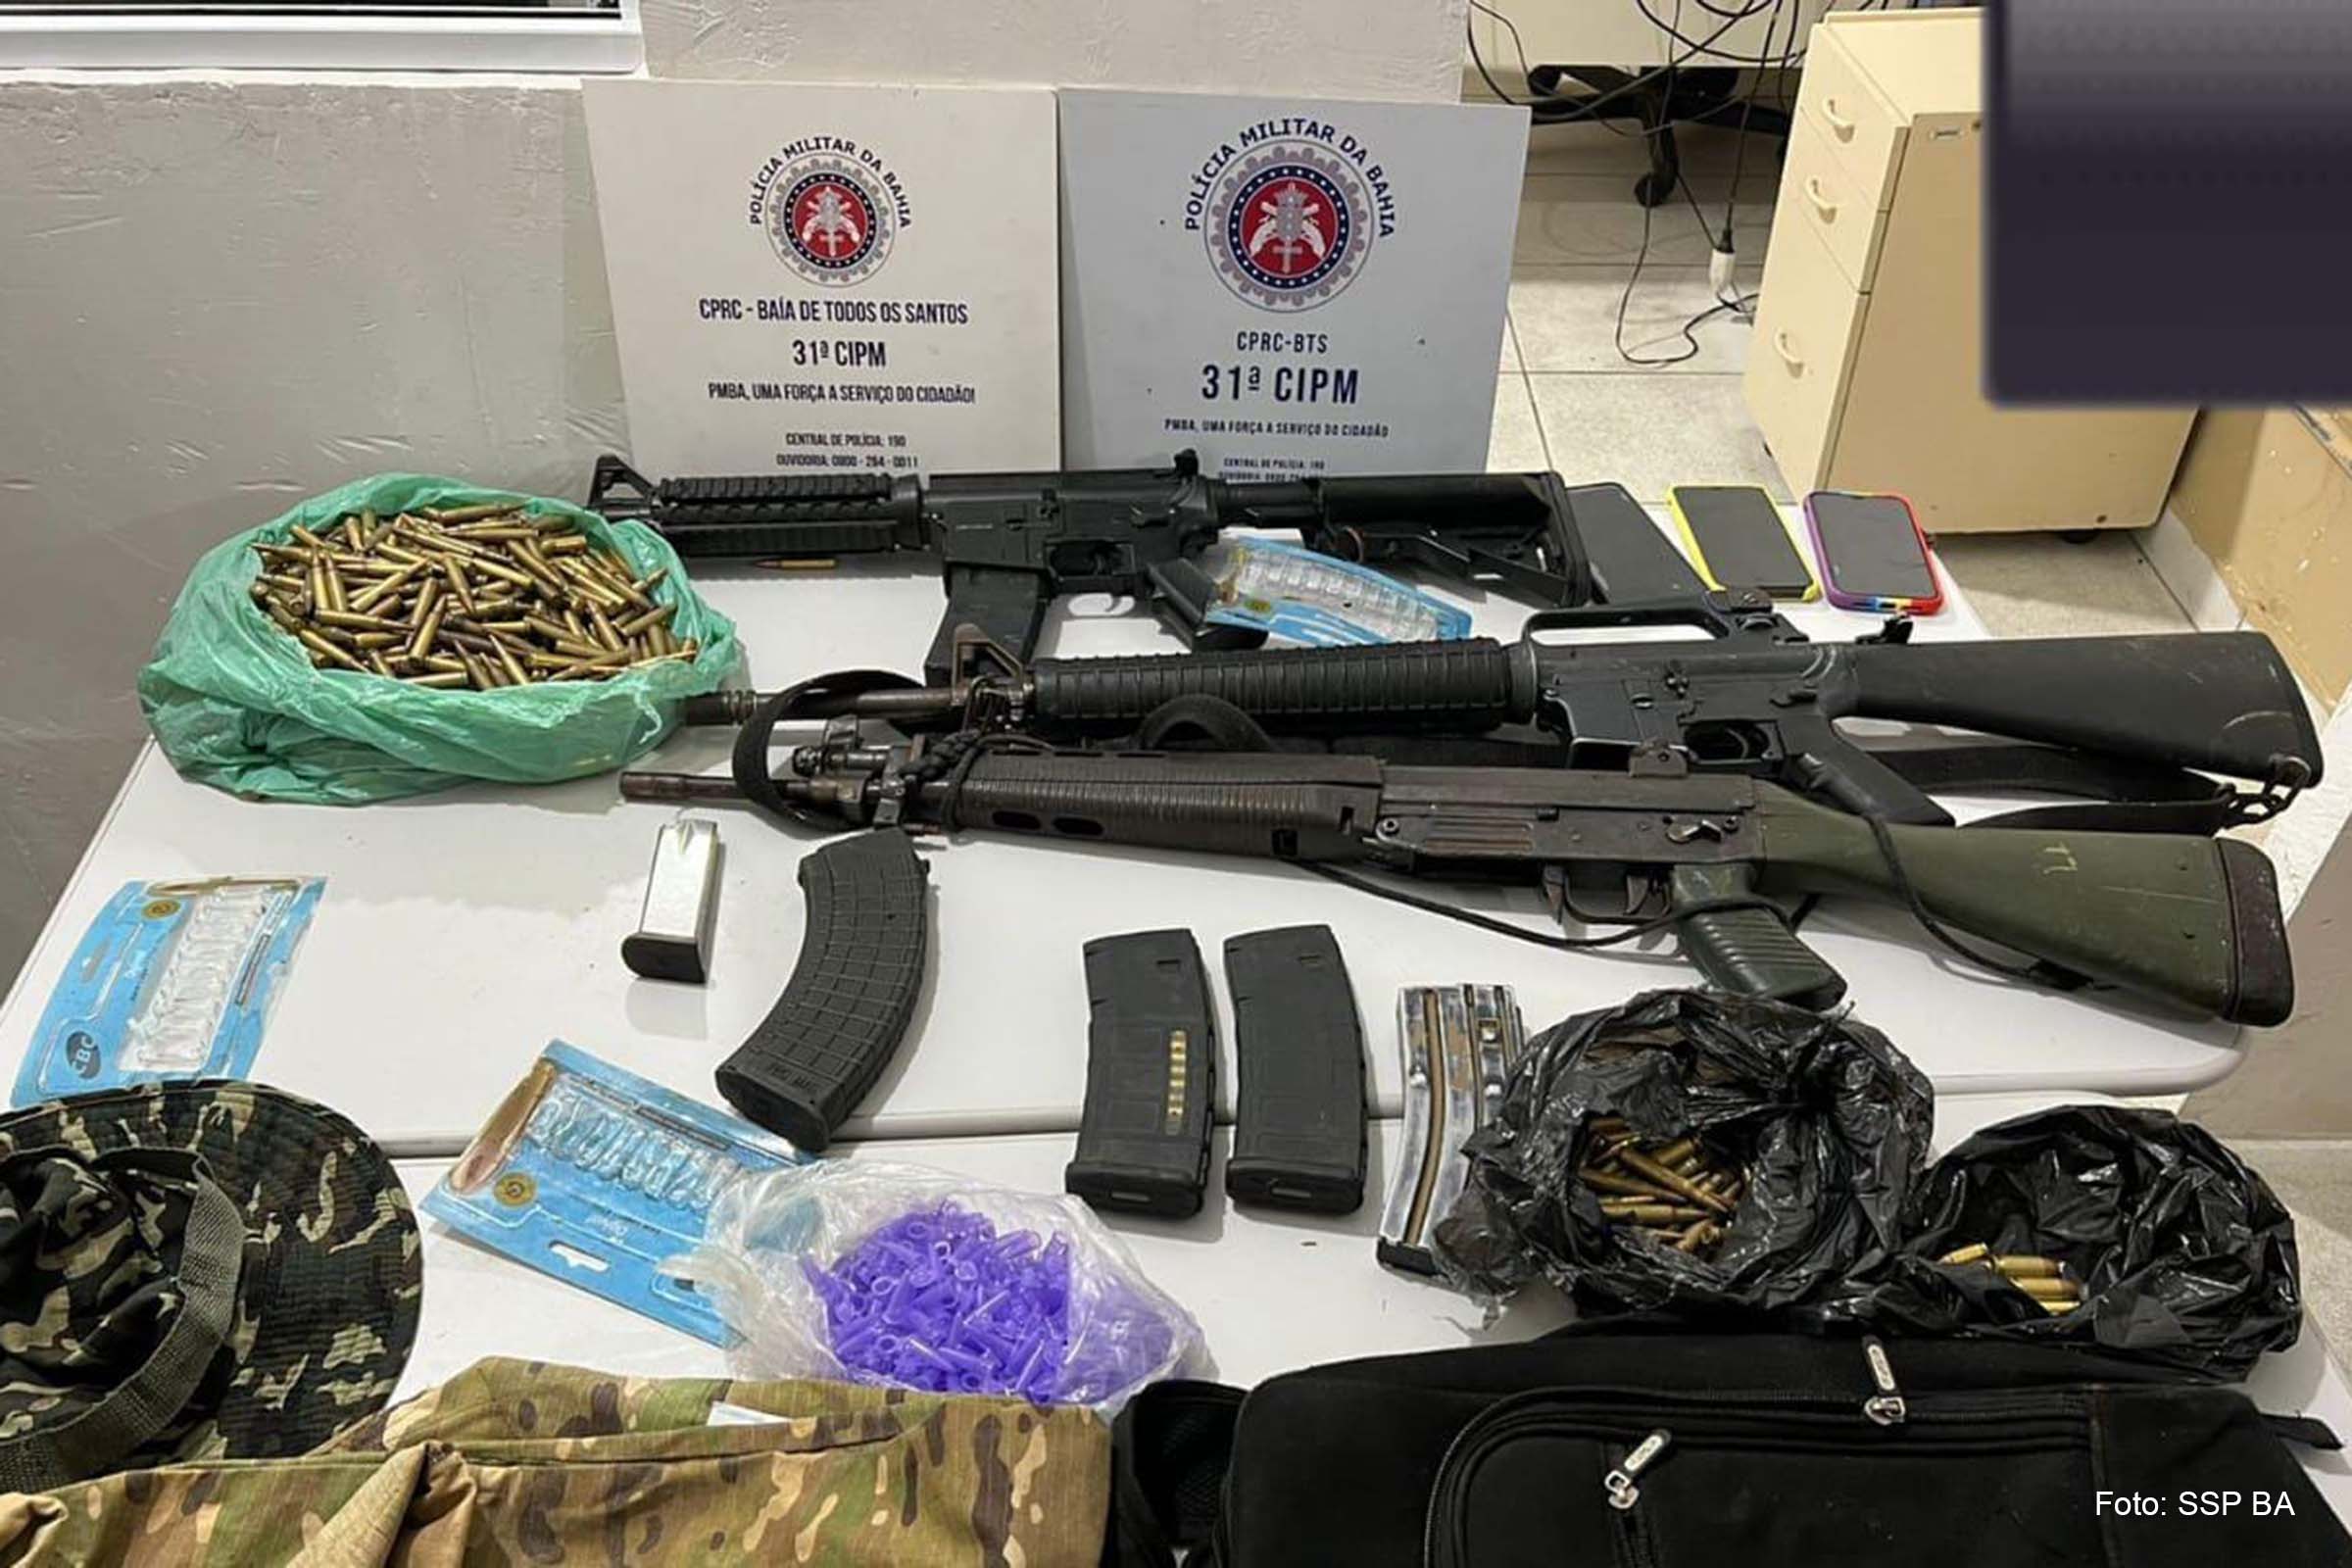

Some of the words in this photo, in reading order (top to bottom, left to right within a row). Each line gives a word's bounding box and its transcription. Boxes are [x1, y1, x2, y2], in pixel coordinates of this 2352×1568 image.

[750, 157, 783, 225] POLÍCIA
[782, 136, 857, 160] MILITAR
[860, 150, 883, 172] DA
[882, 172, 911, 228] BAHIA
[1185, 144, 1237, 230] POLÍCIA
[1240, 118, 1336, 147] MILITAR
[1340, 135, 1368, 166] DA
[1366, 166, 1396, 237] BAHIA
[699, 298, 742, 319] CPRC
[758, 296, 796, 321] BAÍA
[800, 300, 820, 321] DE
[823, 301, 877, 322] TODOS
[880, 302, 902, 323] OS
[905, 303, 968, 324] SANTOS
[835, 340, 887, 367] CIPM
[1237, 331, 1328, 354] CPRC-BTS
[709, 382, 750, 401] PMBA,
[753, 383, 782, 400] UMA
[784, 383, 825, 403] FORÇA
[828, 384, 838, 401] A
[840, 384, 894, 404] SERVIÇO
[897, 386, 914, 403] DO
[1201, 364, 1261, 401] 31ª
[1274, 367, 1358, 405] CIPM
[786, 432, 829, 447] CENTRAL
[830, 433, 844, 447] DE
[1202, 419, 1225, 432] UMA
[1229, 419, 1263, 435] FORÇA
[1266, 421, 1274, 433] A
[1276, 421, 1321, 437] SERVIÇO
[1324, 423, 1340, 436] DO
